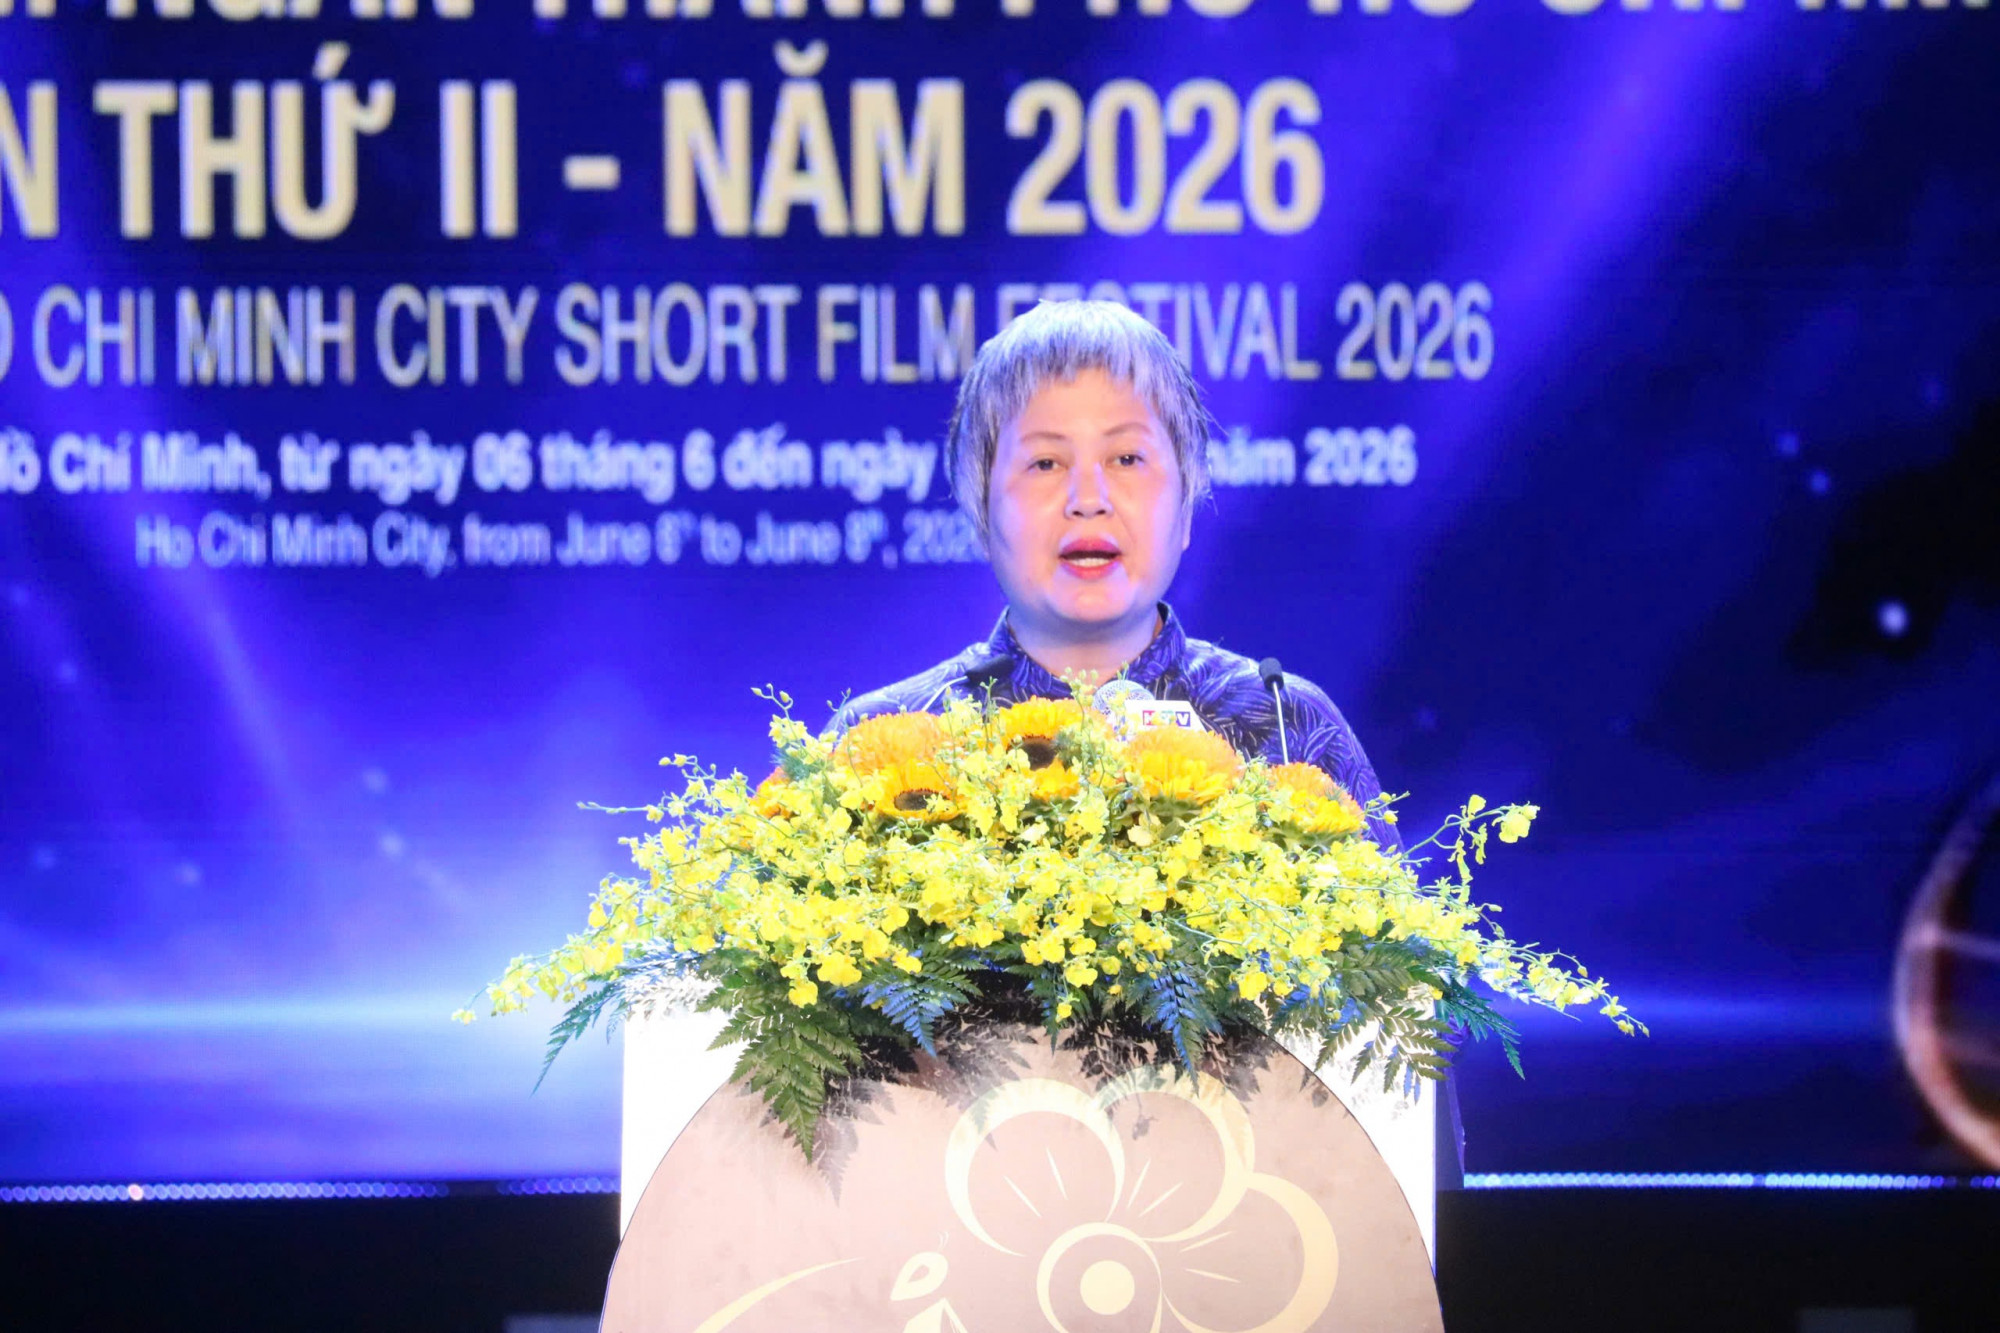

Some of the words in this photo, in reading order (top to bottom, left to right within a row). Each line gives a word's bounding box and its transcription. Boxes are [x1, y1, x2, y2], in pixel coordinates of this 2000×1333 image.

[93, 43, 395, 238] THỨ
[440, 81, 517, 237] II
[564, 157, 619, 189] -
[664, 42, 965, 236] NĂM
[1006, 78, 1325, 236] 2026
[32, 284, 154, 386] CHI
[177, 287, 354, 384] MINH
[375, 284, 539, 386] CITY
[555, 283, 800, 386] SHORT
[818, 285, 974, 382] FILM
[1336, 282, 1494, 380] 2026
[349, 431, 465, 504] ngày
[473, 431, 532, 491] 06
[539, 431, 675, 503] tháng
[683, 430, 715, 490] 6
[1305, 425, 1417, 485] 2026
[136, 514, 194, 567] Ho
[198, 511, 266, 567] Chi
[272, 514, 367, 566] Minh
[463, 513, 551, 565] from
[556, 514, 651, 565] June
[700, 514, 742, 565] to
[745, 512, 841, 565] June
